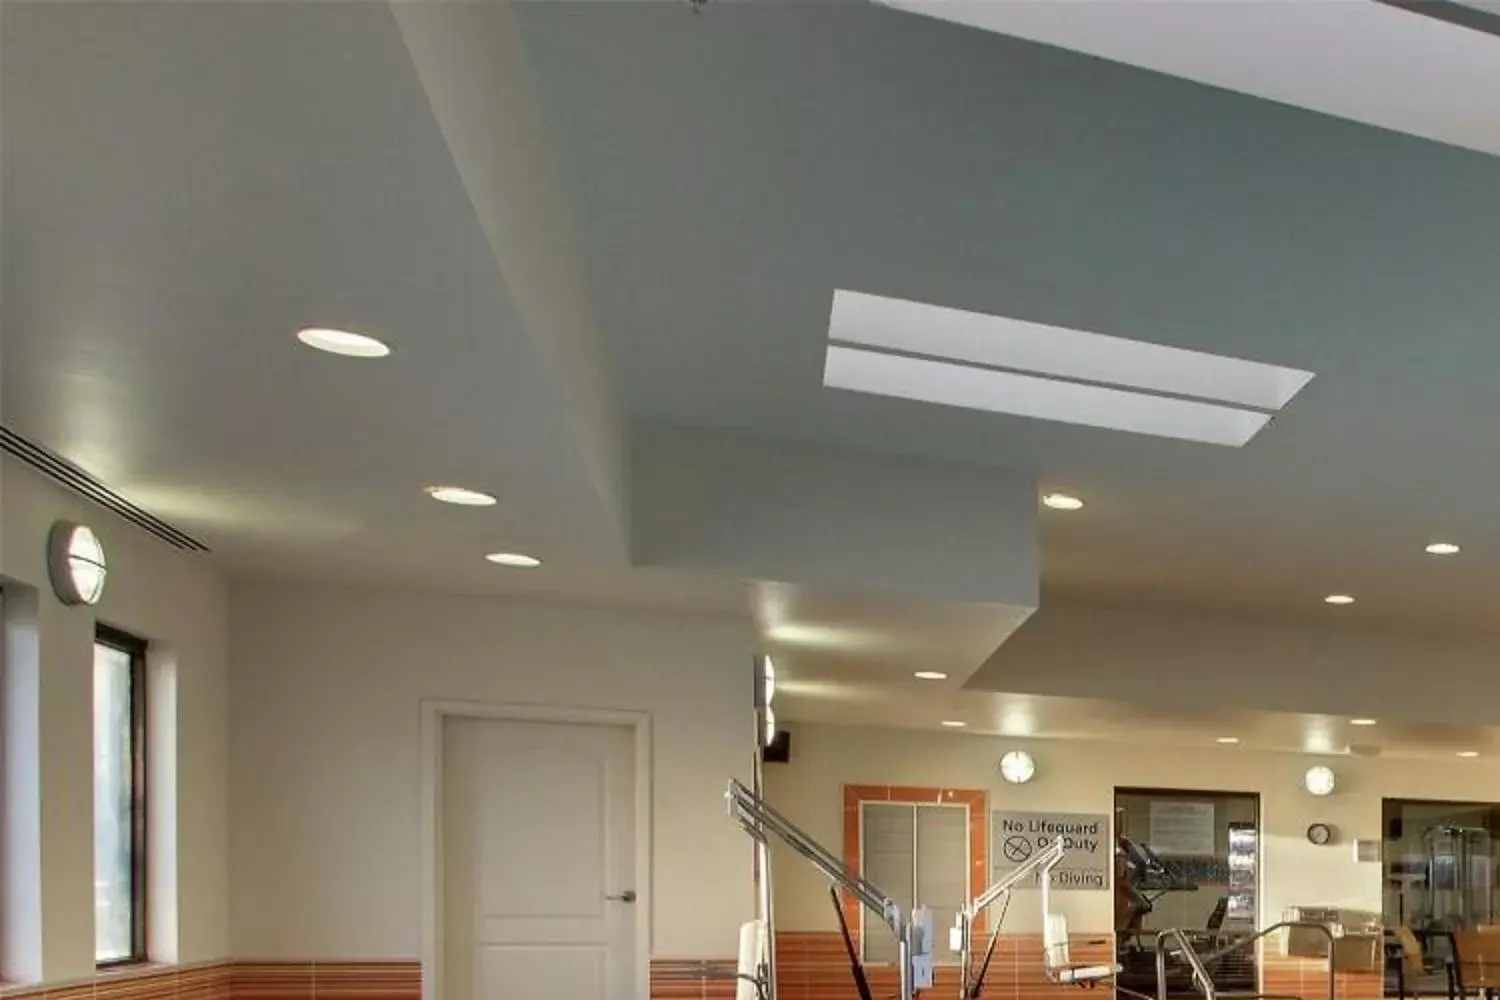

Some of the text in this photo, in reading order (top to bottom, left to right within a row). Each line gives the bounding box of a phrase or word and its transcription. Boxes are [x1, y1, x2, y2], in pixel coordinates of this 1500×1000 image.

[1003, 819, 1098, 835] No Lifeguard
[1063, 836, 1099, 853] Duty
[1059, 871, 1103, 887] Diving
